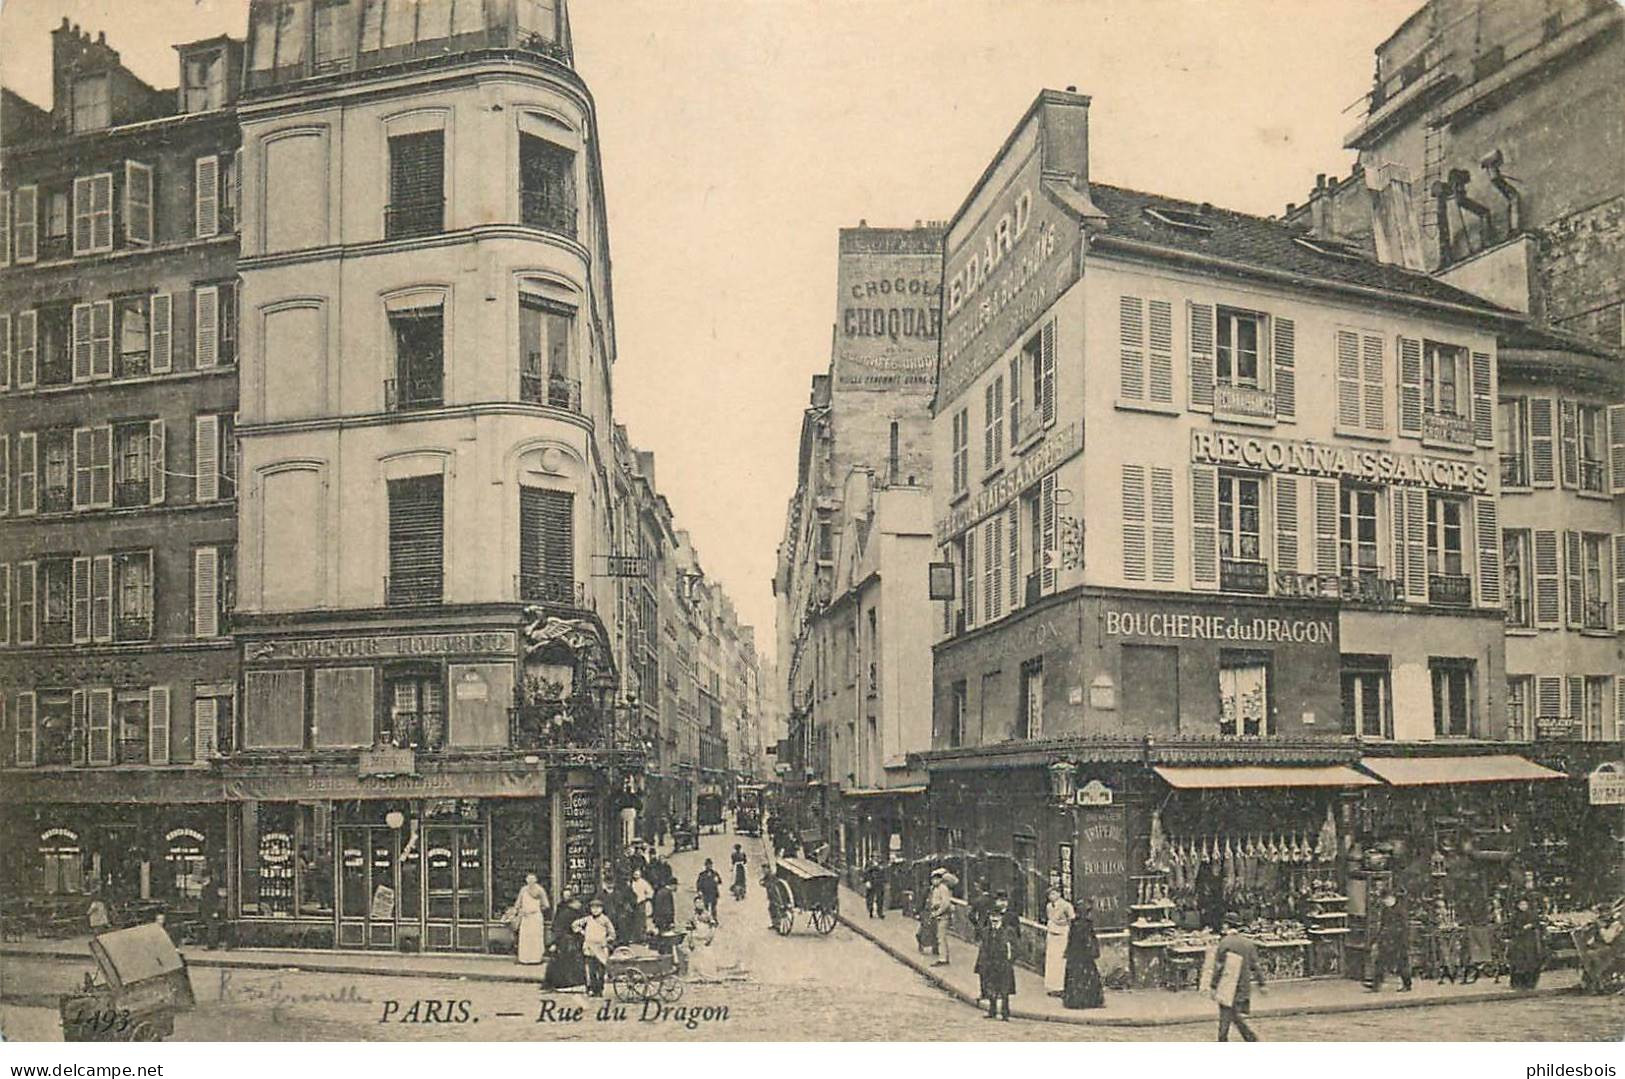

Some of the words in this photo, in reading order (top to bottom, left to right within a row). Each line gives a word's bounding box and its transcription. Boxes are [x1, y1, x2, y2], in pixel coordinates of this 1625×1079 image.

[1194, 431, 1489, 492] RECONNAISSANCES
[1106, 611, 1225, 640] BOUCHERIE
[1226, 619, 1253, 641] du
[1252, 619, 1333, 644] DRAGON
[379, 999, 480, 1024] PARIS.
[536, 999, 584, 1023] Rue
[596, 999, 628, 1023] du
[638, 999, 731, 1030] Dragon
